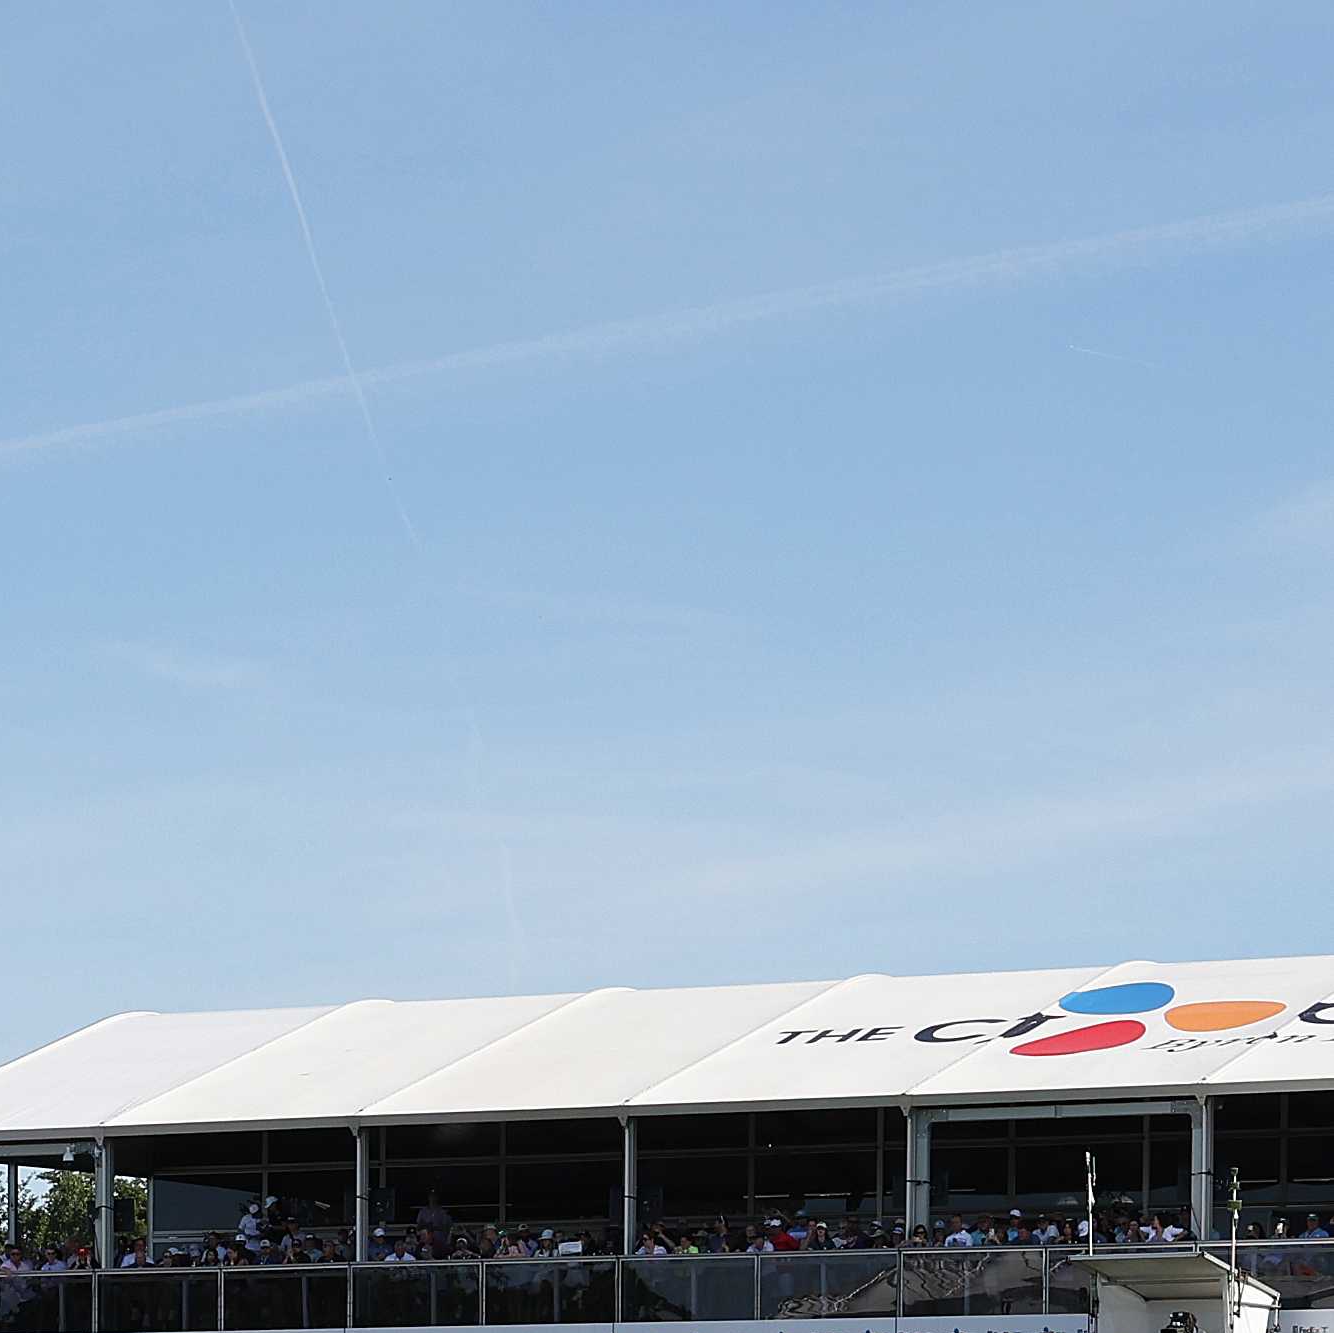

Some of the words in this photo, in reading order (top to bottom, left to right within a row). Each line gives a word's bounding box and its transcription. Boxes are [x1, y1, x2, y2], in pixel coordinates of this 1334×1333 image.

[776, 1026, 905, 1044] THE
[914, 1012, 1066, 1045] CJ
[1141, 1032, 1316, 1052] Byron
